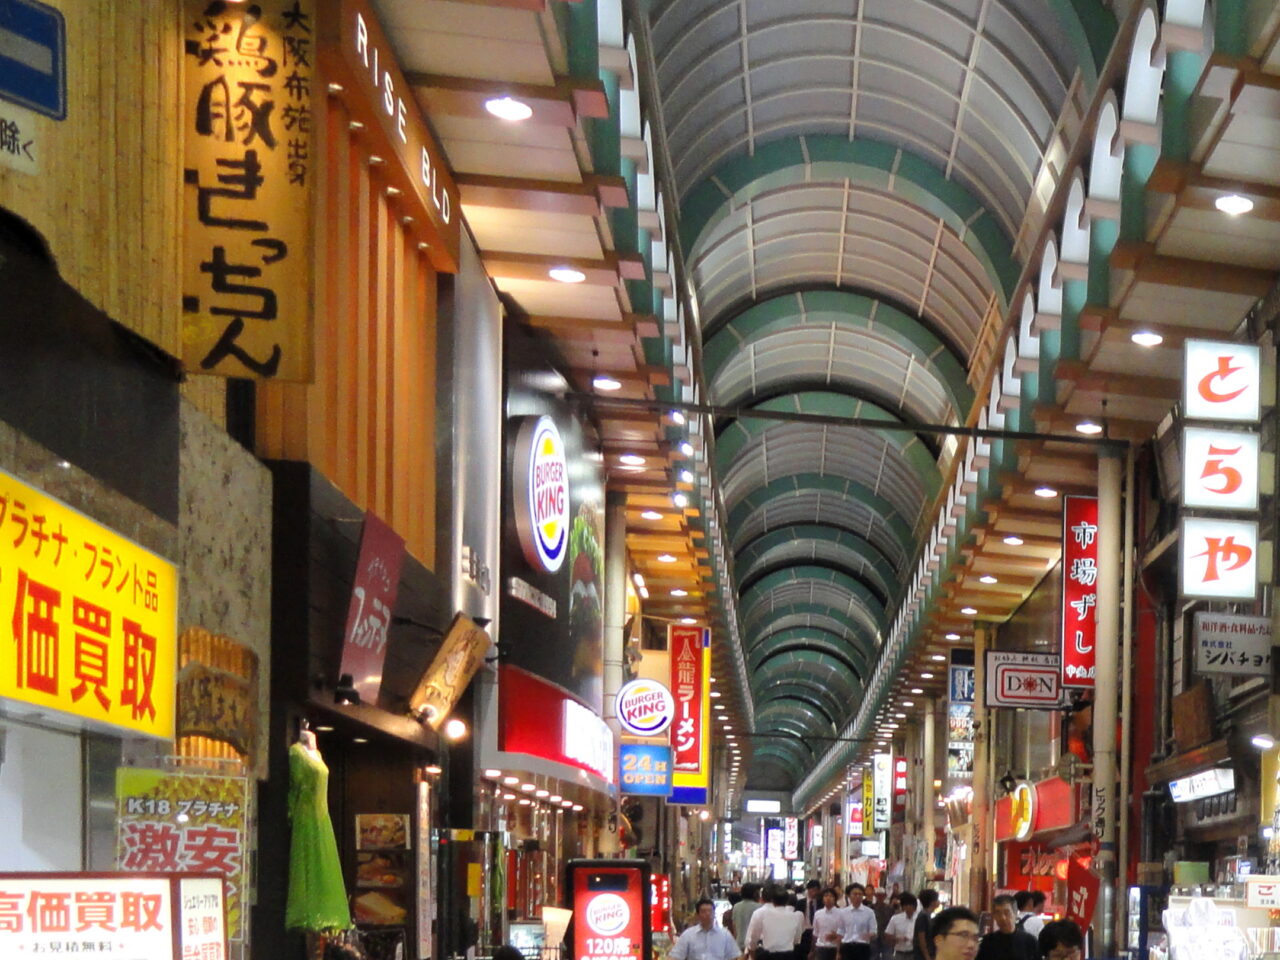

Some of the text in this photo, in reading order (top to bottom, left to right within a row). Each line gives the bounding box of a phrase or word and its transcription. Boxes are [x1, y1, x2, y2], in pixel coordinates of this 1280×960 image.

[356, 13, 450, 225] RISE BLD
[535, 461, 564, 488] BURGER
[1189, 355, 1253, 583] とらや
[536, 487, 565, 525] KING
[1071, 520, 1098, 655] 市場ずし
[624, 691, 664, 709] BURGER
[626, 700, 666, 723] KING
[623, 755, 651, 772] 24
[623, 774, 667, 785] OPEN
[128, 799, 239, 817] K18 プラチナ
[122, 822, 243, 877] 激安
[0, 890, 164, 933] 高価買取
[594, 909, 623, 925] KING
[586, 937, 631, 955] 120席
